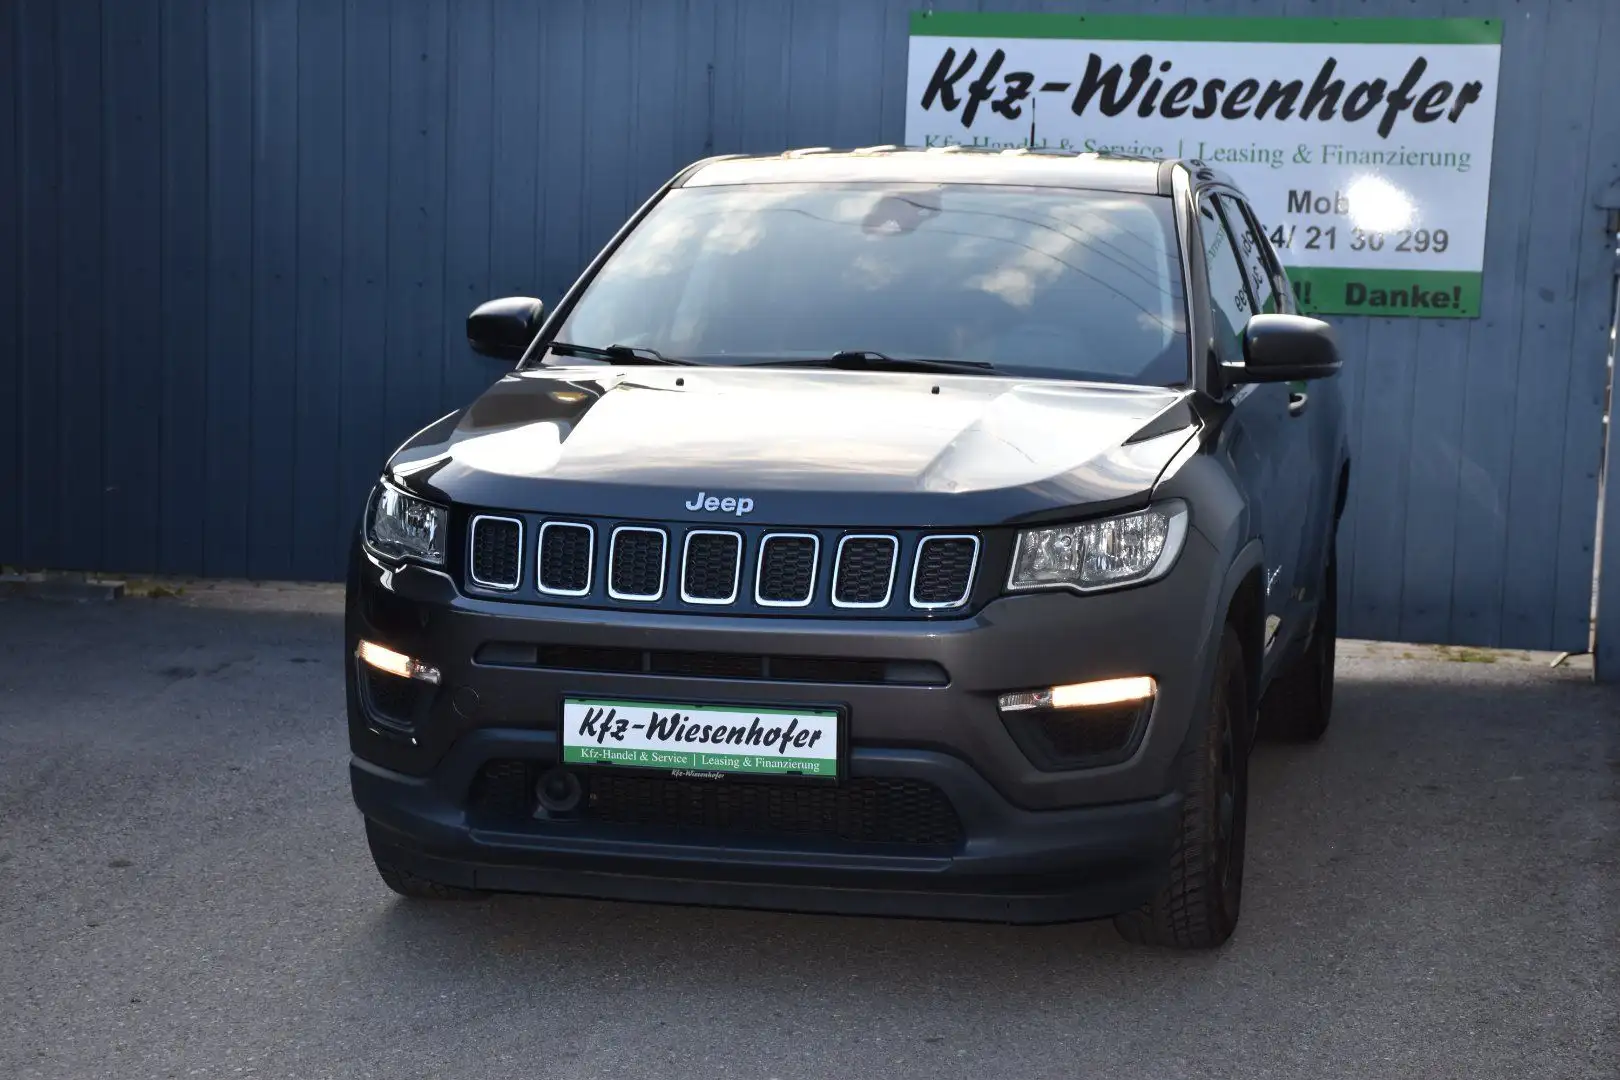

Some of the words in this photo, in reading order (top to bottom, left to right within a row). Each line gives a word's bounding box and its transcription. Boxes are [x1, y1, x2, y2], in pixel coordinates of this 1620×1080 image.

[922, 46, 1483, 140] Kfz-Wiesenhofer
[1198, 141, 1284, 169] Leasing
[1292, 144, 1313, 164] &
[1321, 144, 1472, 172] Finanzierung
[1304, 225, 1337, 250] 21
[1349, 226, 1385, 252] 30
[1395, 228, 1450, 253] 299
[1344, 281, 1462, 309] Danke!
[685, 491, 754, 517] Jeep
[578, 707, 823, 754] Kfz-Wiesenhofer
[580, 748, 637, 761] Kfz-Handel
[639, 751, 649, 761] &
[651, 752, 688, 764] Service
[701, 754, 740, 768] Leasing
[742, 757, 752, 767] &
[755, 757, 820, 772] Finanzierung
